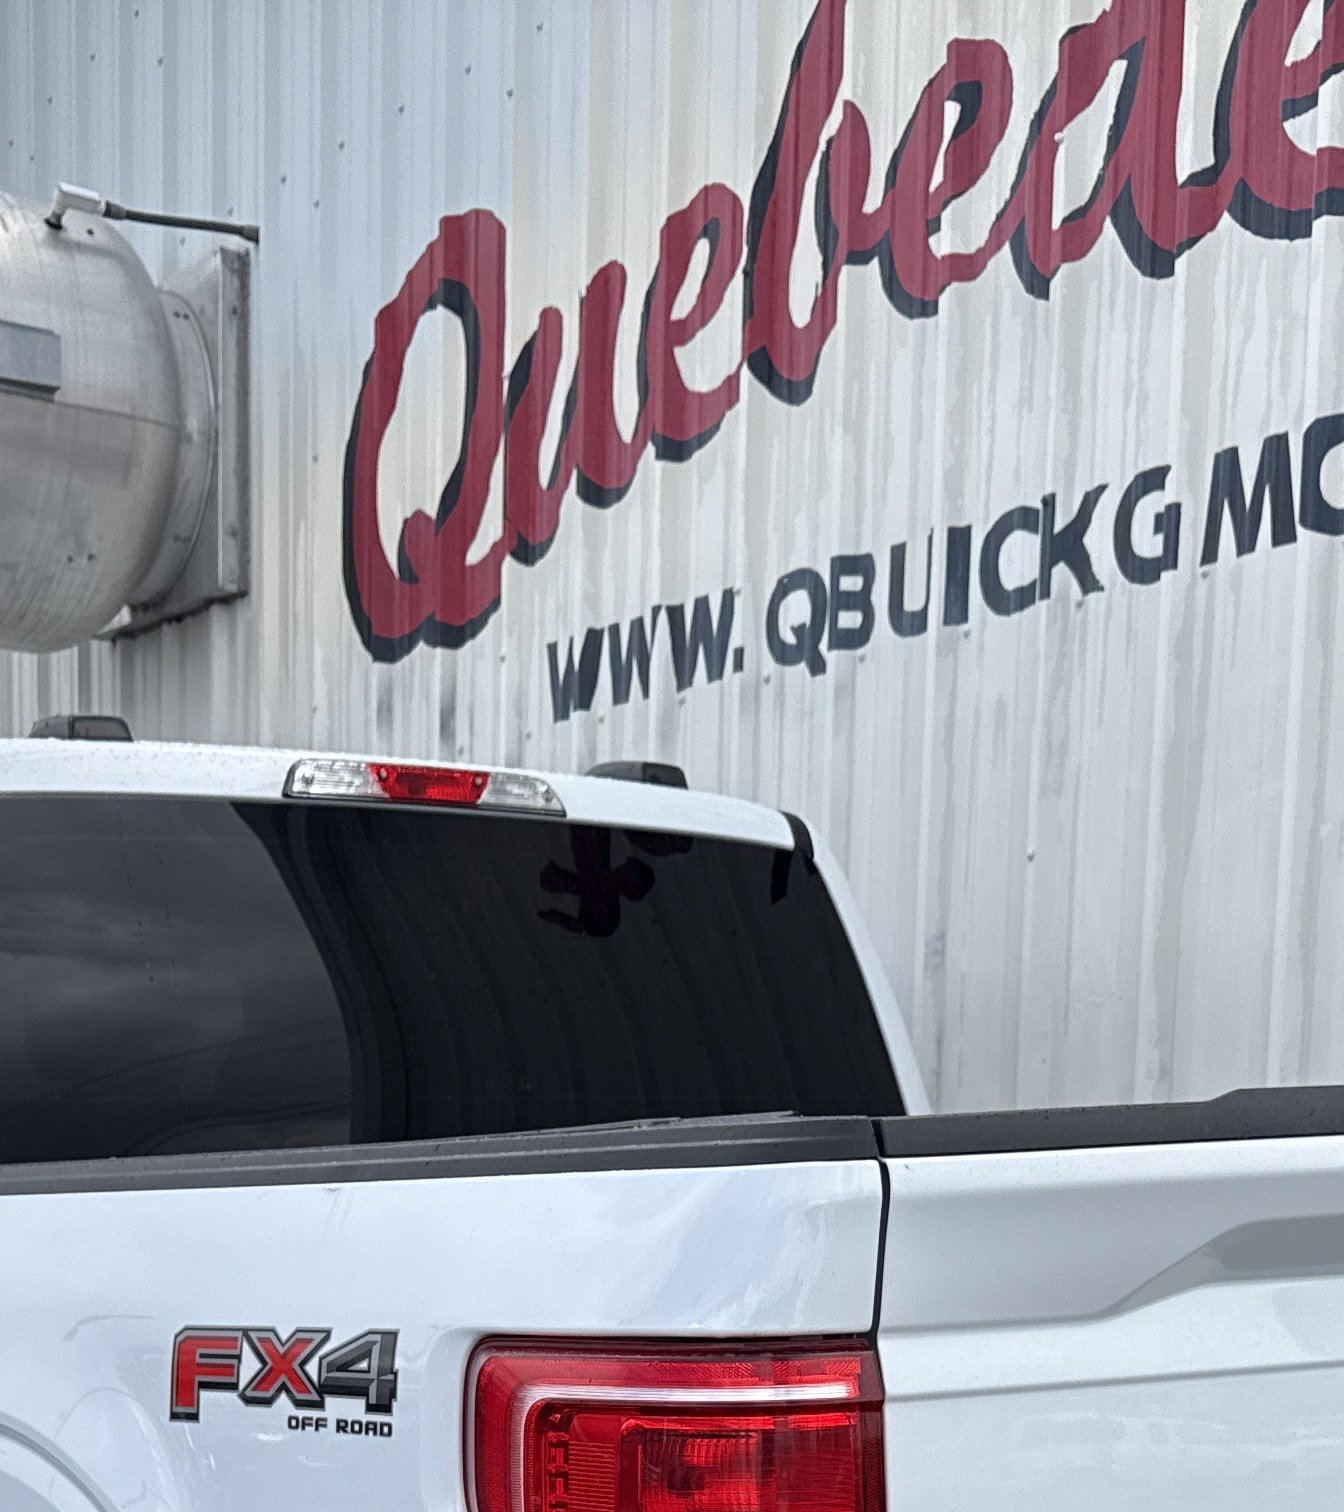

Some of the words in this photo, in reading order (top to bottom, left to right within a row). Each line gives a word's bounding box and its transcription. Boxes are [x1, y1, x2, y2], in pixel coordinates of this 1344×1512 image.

[169, 1325, 400, 1423] FX4
[287, 1415, 328, 1432] OFF
[335, 1418, 393, 1437] ROAD
